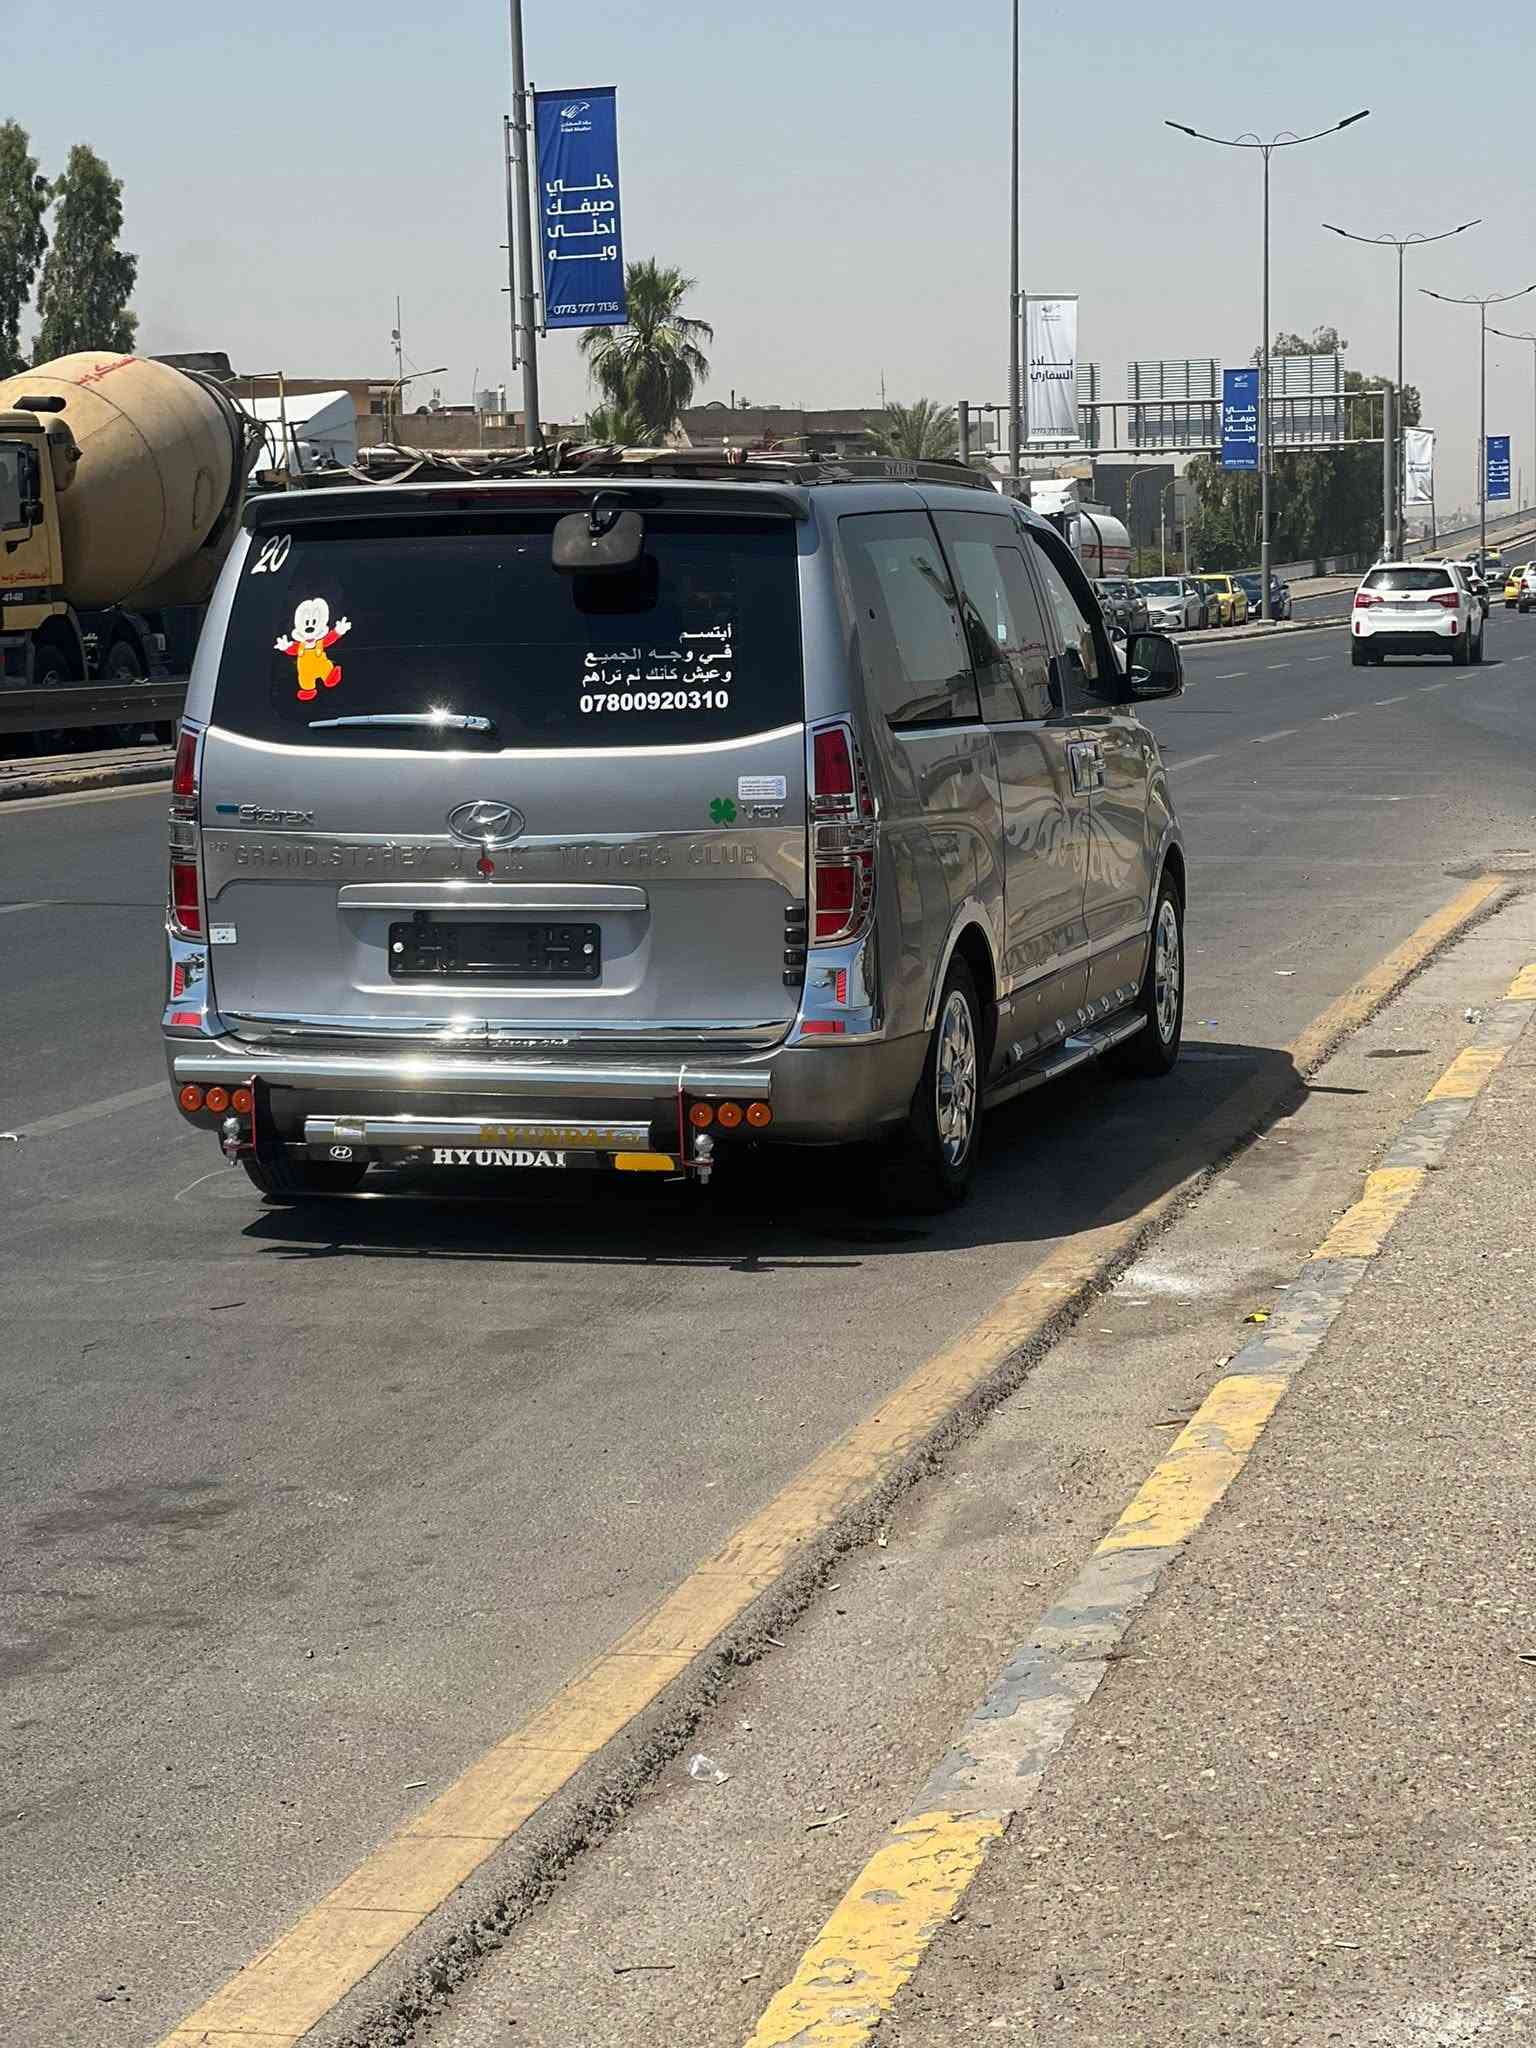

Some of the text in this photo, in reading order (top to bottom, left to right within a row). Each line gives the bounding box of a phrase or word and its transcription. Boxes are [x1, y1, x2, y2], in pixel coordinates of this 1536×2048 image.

[546, 173, 613, 197] خلي
[546, 198, 614, 216] صيفك
[547, 218, 615, 238] احلى
[548, 245, 616, 260] ويه
[250, 534, 292, 574] 20
[584, 644, 732, 668] في وجه الجميع
[582, 669, 622, 688] تراهم
[626, 668, 641, 686] لم
[579, 690, 729, 713] 07800920310
[432, 1147, 567, 1167] HYUNDAI
